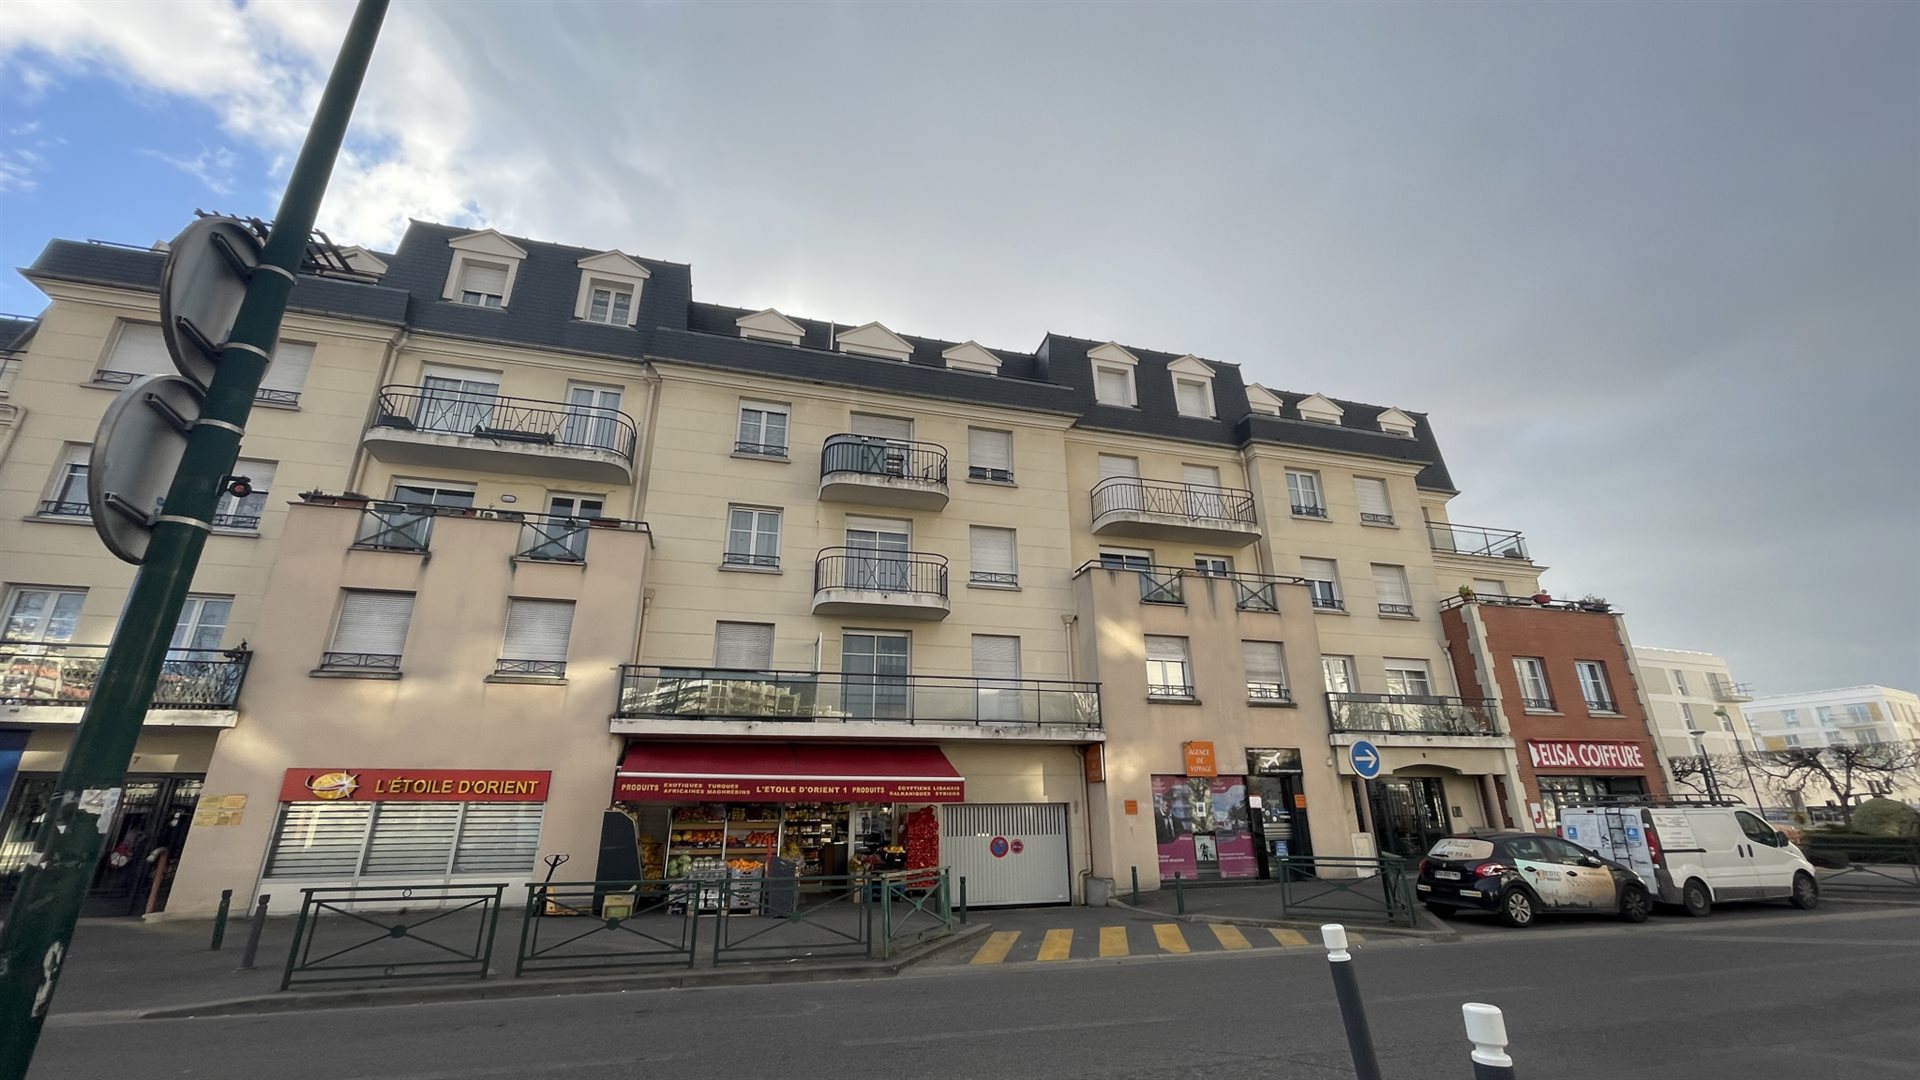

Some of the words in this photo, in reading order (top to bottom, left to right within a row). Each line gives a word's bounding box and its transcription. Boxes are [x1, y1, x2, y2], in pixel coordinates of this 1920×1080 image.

[1538, 743, 1579, 766] ELISA
[1579, 744, 1644, 767] COIFFURE
[375, 776, 453, 793] L'ÉTOILE
[457, 779, 538, 794] D'ORIENT
[621, 783, 659, 791] PRODUITS
[852, 786, 885, 794] PRODUITS
